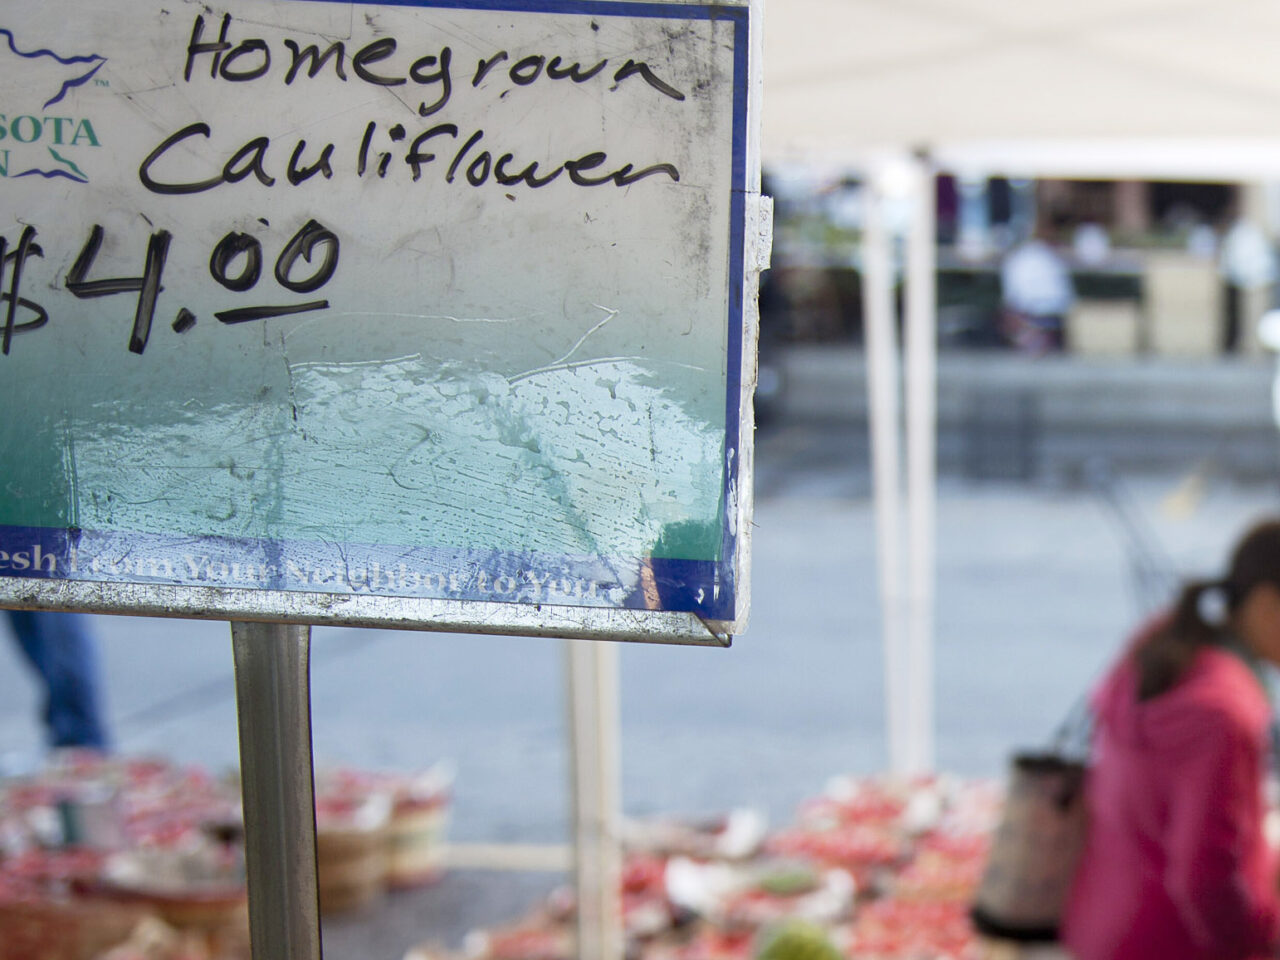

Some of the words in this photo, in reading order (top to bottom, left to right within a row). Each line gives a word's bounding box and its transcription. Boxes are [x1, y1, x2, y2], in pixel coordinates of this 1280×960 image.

[185, 13, 685, 116] Homegrown
[139, 121, 680, 194] Cauliflower
[0, 218, 341, 355] $4.00
